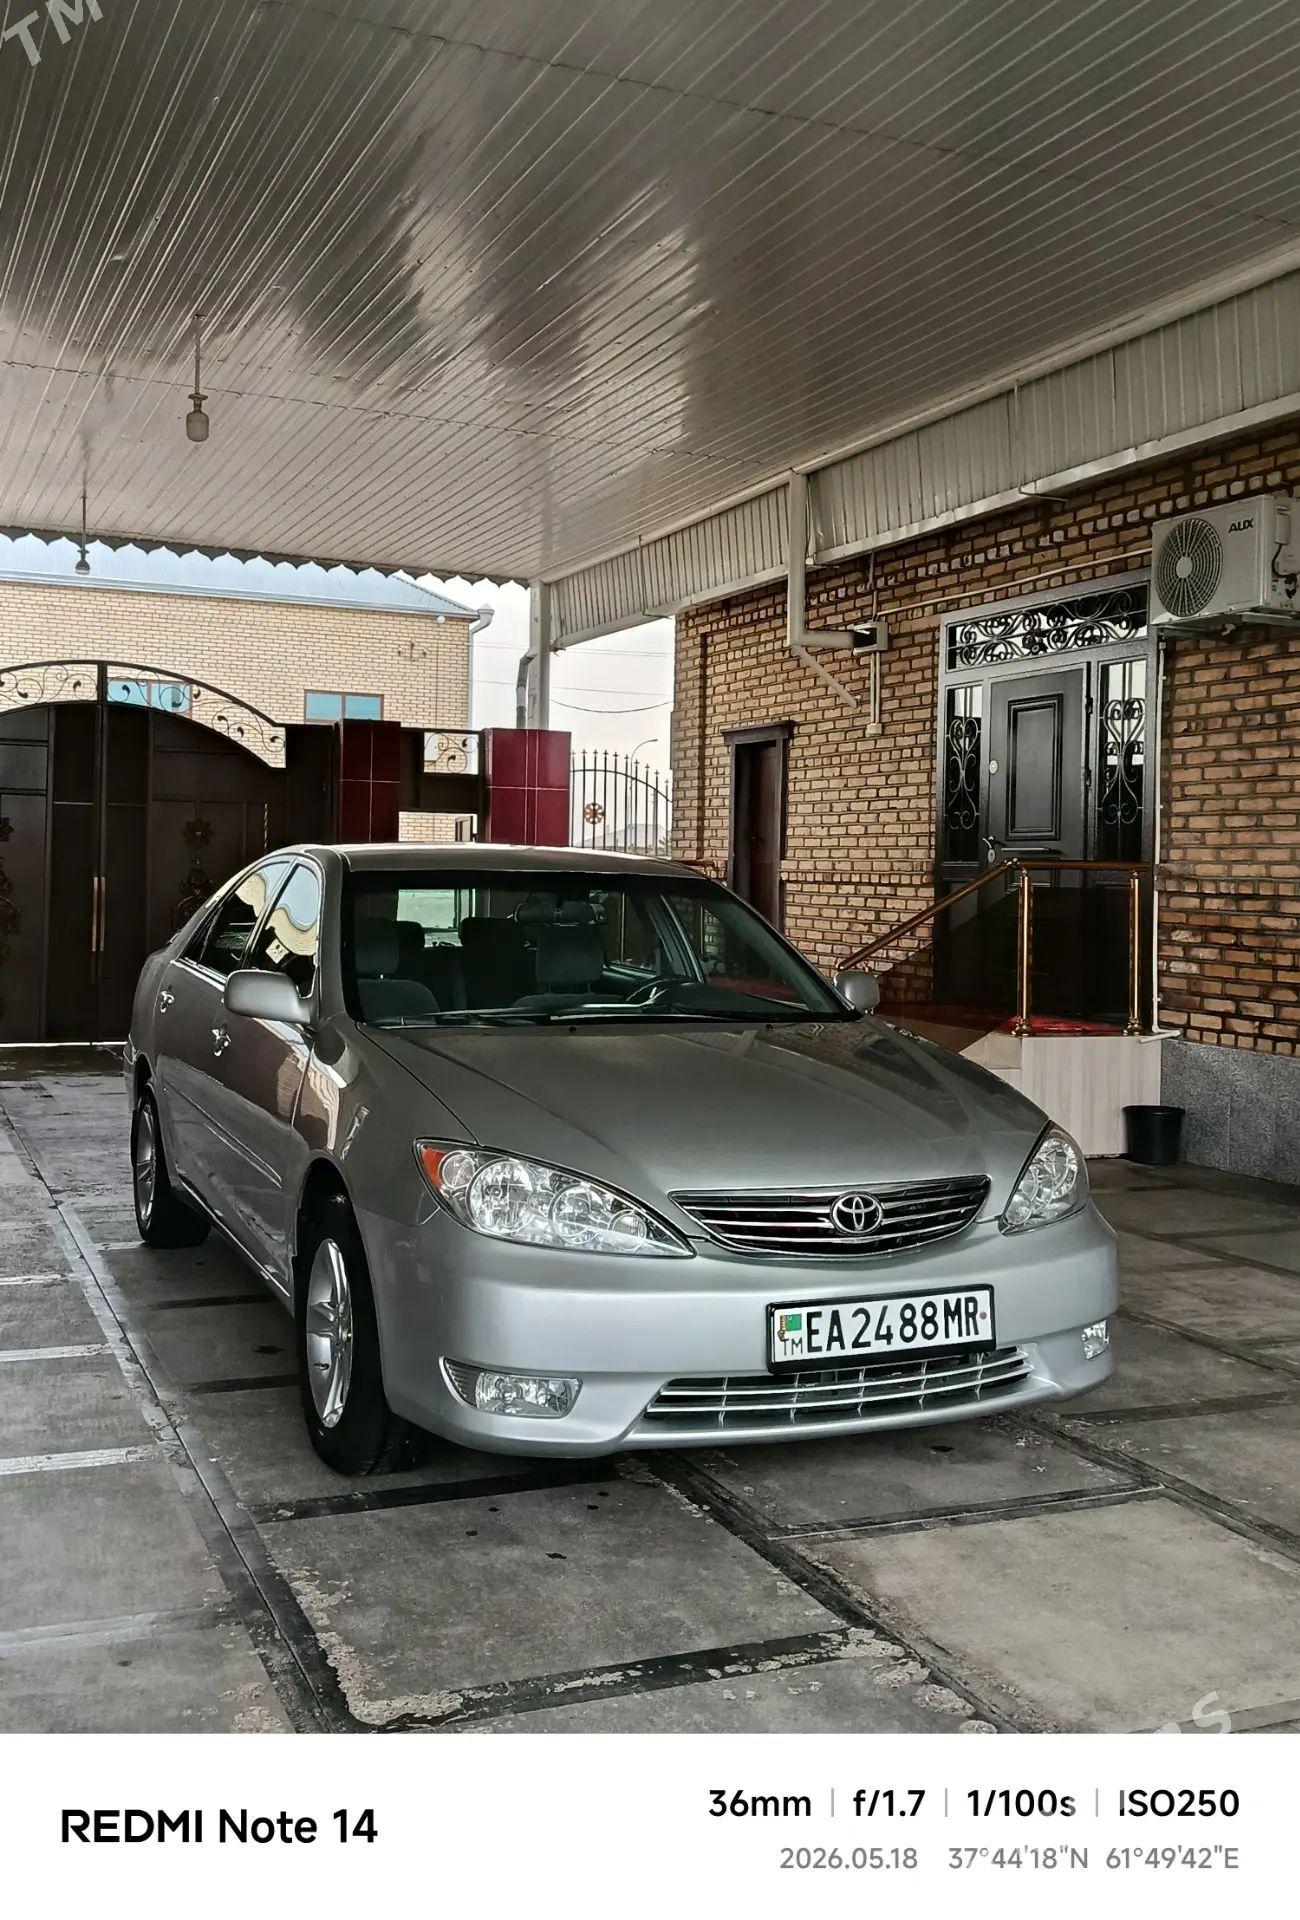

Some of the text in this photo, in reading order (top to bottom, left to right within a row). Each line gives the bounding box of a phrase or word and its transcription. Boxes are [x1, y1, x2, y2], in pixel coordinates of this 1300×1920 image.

[1228, 518, 1254, 533] AUX
[806, 1296, 979, 1354] EA2488MR
[780, 1337, 803, 1356] TM
